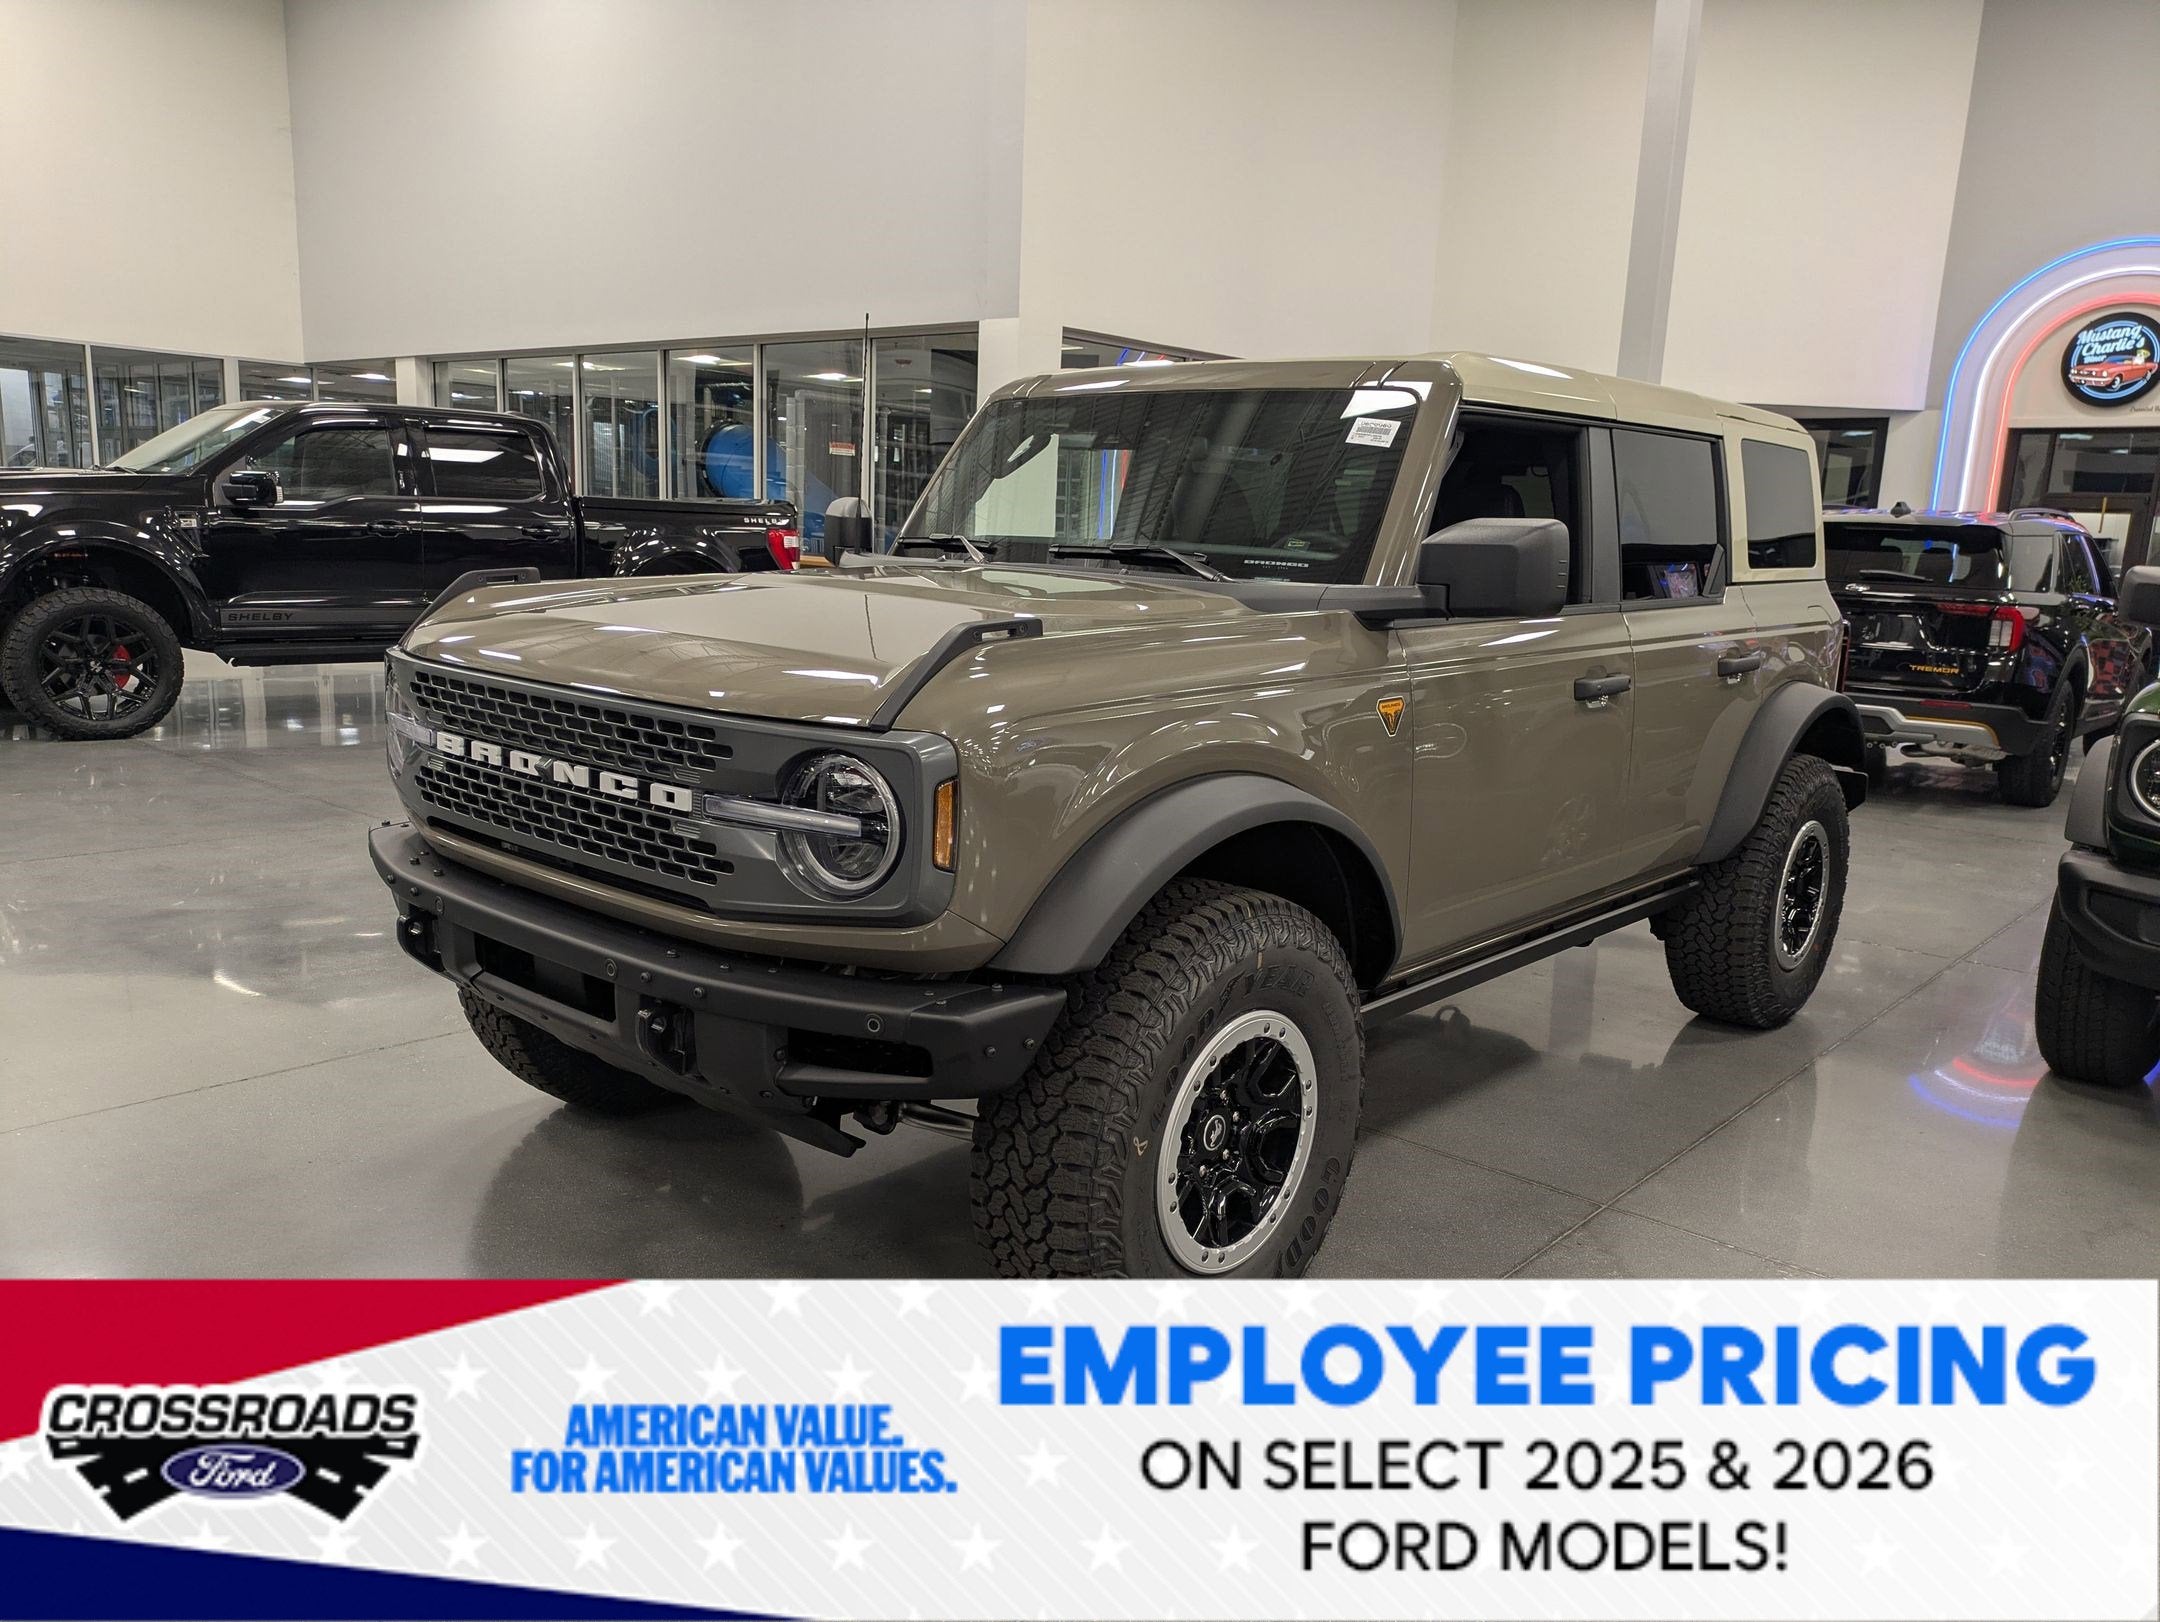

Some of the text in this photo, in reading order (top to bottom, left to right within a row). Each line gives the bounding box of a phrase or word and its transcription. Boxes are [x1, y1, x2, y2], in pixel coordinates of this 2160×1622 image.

[2077, 325, 2142, 345] Mustang
[2081, 337, 2145, 356] Charlie's
[228, 612, 293, 621] SHELBY
[1908, 664, 1960, 674] TREMOR
[436, 731, 693, 812] BRONCO
